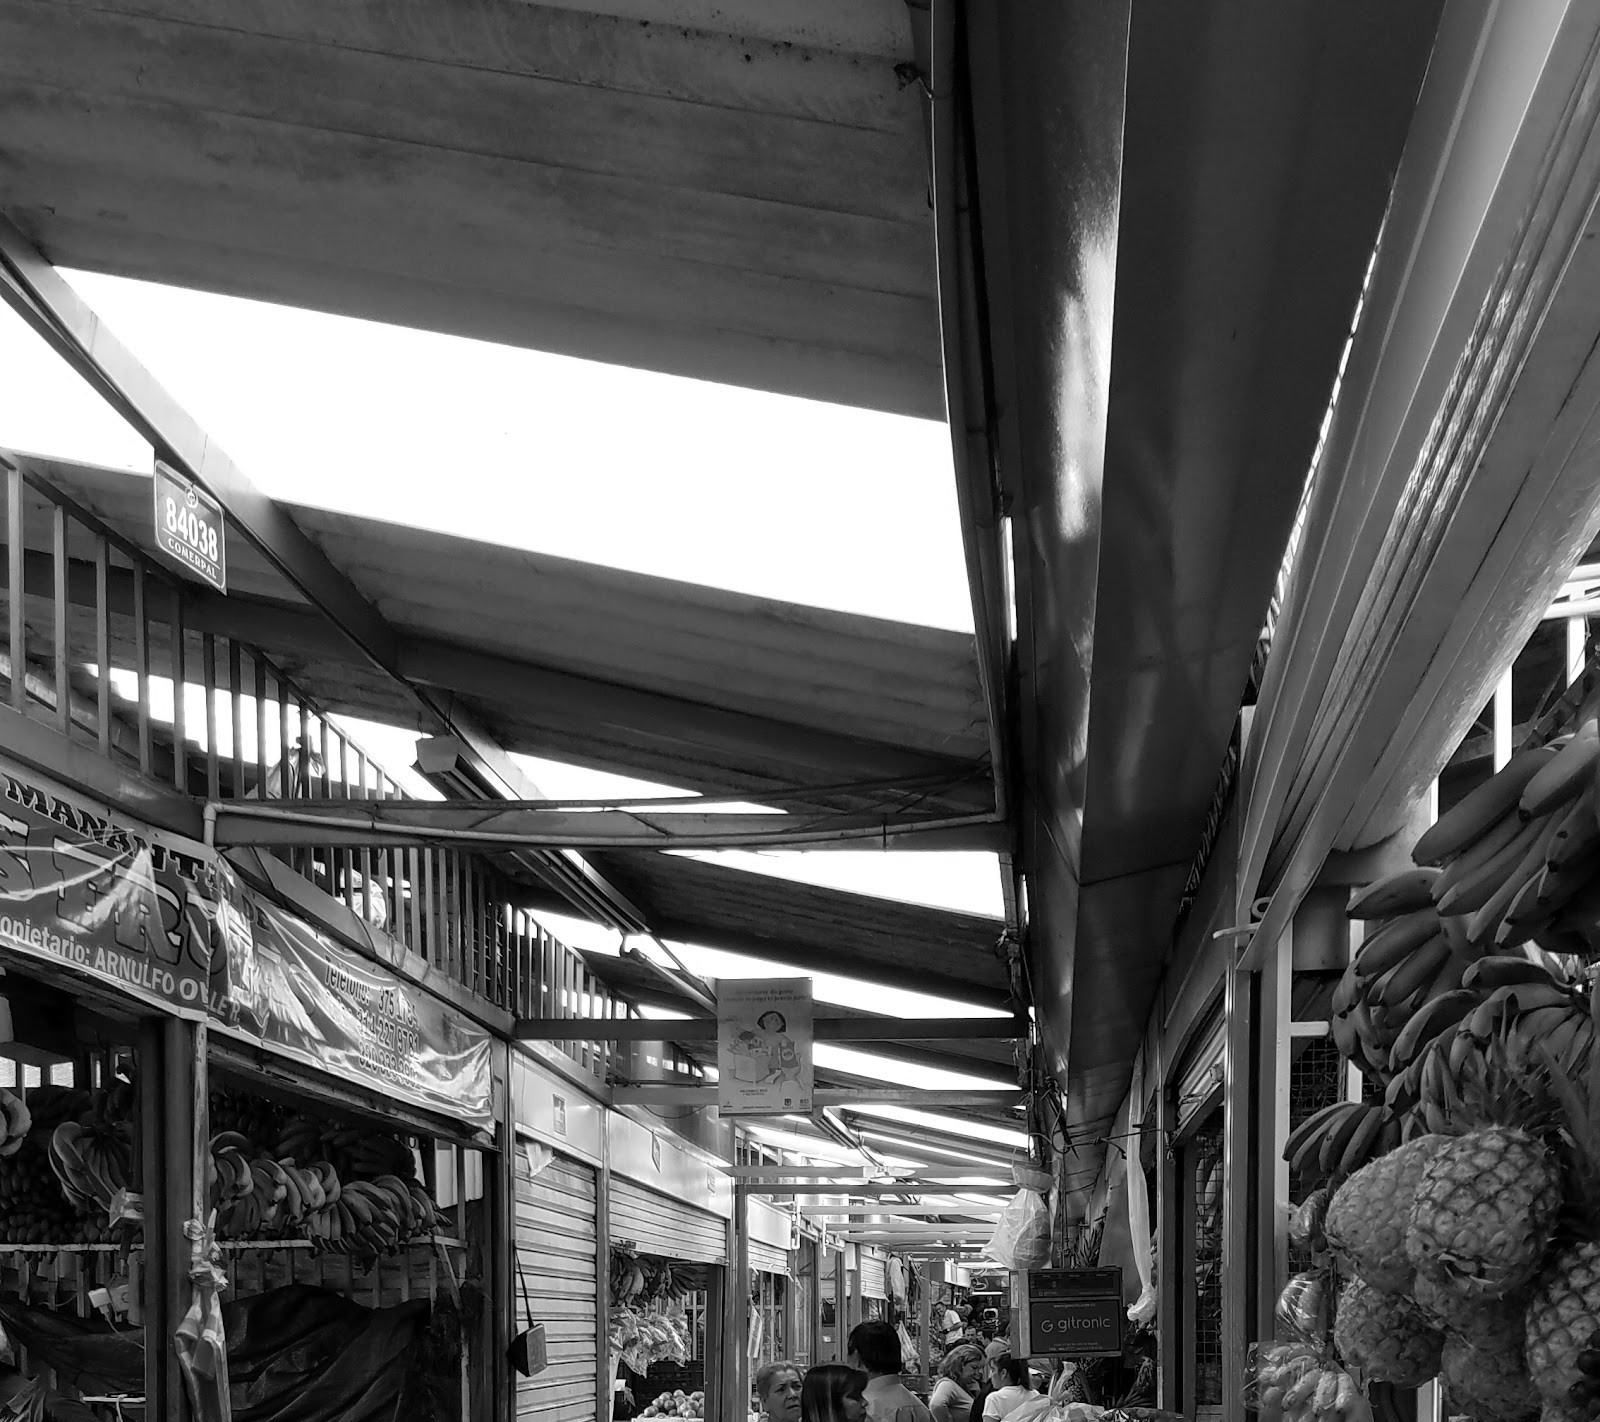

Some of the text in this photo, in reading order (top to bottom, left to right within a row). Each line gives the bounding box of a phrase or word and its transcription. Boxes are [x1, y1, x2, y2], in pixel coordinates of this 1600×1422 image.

[165, 496, 218, 562] 84038
[168, 537, 217, 580] COMERPAL
[94, 946, 175, 995] ARNULFO
[377, 1015, 396, 1051] 227
[1057, 1316, 1111, 1333] gitronic
